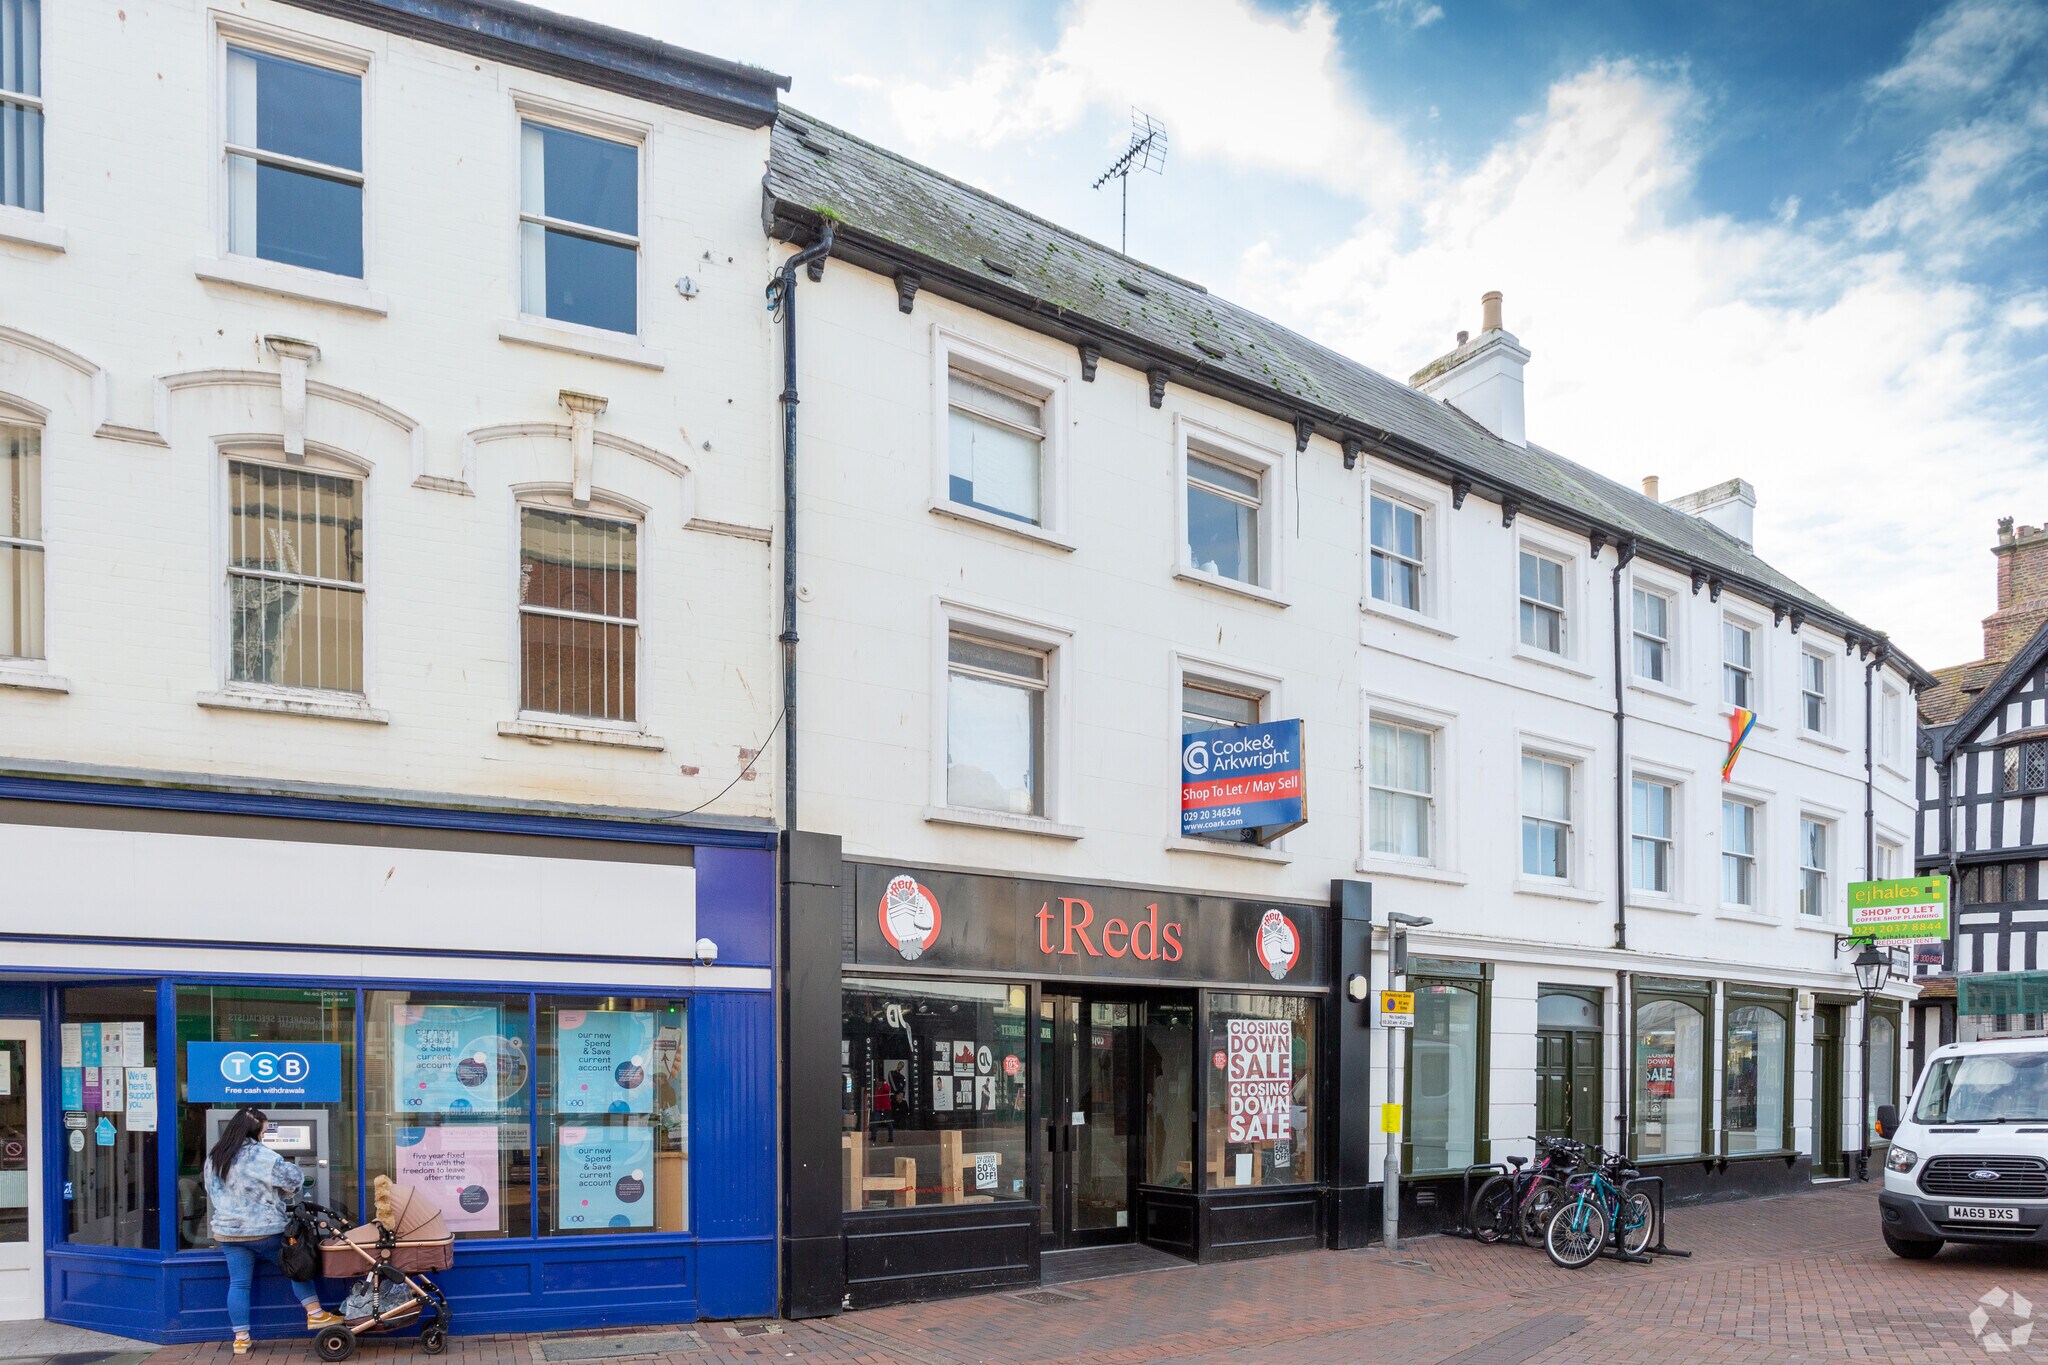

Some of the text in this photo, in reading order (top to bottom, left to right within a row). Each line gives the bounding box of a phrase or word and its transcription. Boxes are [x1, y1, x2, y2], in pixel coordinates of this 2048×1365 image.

[1213, 749, 1289, 772] Arkwright
[1184, 789, 1209, 800] Shop
[1212, 786, 1223, 797] To
[1226, 784, 1242, 795] Let
[1253, 781, 1275, 793] May
[1278, 776, 1297, 789] Sell
[1184, 807, 1241, 821] 029 20 346346
[1184, 819, 1243, 831] www.coark.com
[889, 880, 915, 897] tReds
[1264, 912, 1282, 927] tReds
[1035, 897, 1183, 962] tReds
[1880, 924, 1908, 932] 2037
[1230, 1022, 1289, 1035] CLOSING
[423, 1036, 450, 1044] Spend
[585, 1040, 610, 1048] Spend
[1231, 1036, 1289, 1053] DOWN
[1231, 1054, 1290, 1080] SALE
[128, 1071, 148, 1080] We're
[128, 1082, 144, 1090] here
[1230, 1082, 1290, 1097] CLOSING
[128, 1092, 155, 1100] support
[128, 1102, 143, 1110] you.
[1230, 1096, 1290, 1115] DOWN
[1230, 1114, 1290, 1141] SALE
[585, 1155, 611, 1164] Spend
[977, 1164, 995, 1172] 50%
[977, 1172, 996, 1180] OFF!
[1954, 1208, 2013, 1219] MA69 BXS
